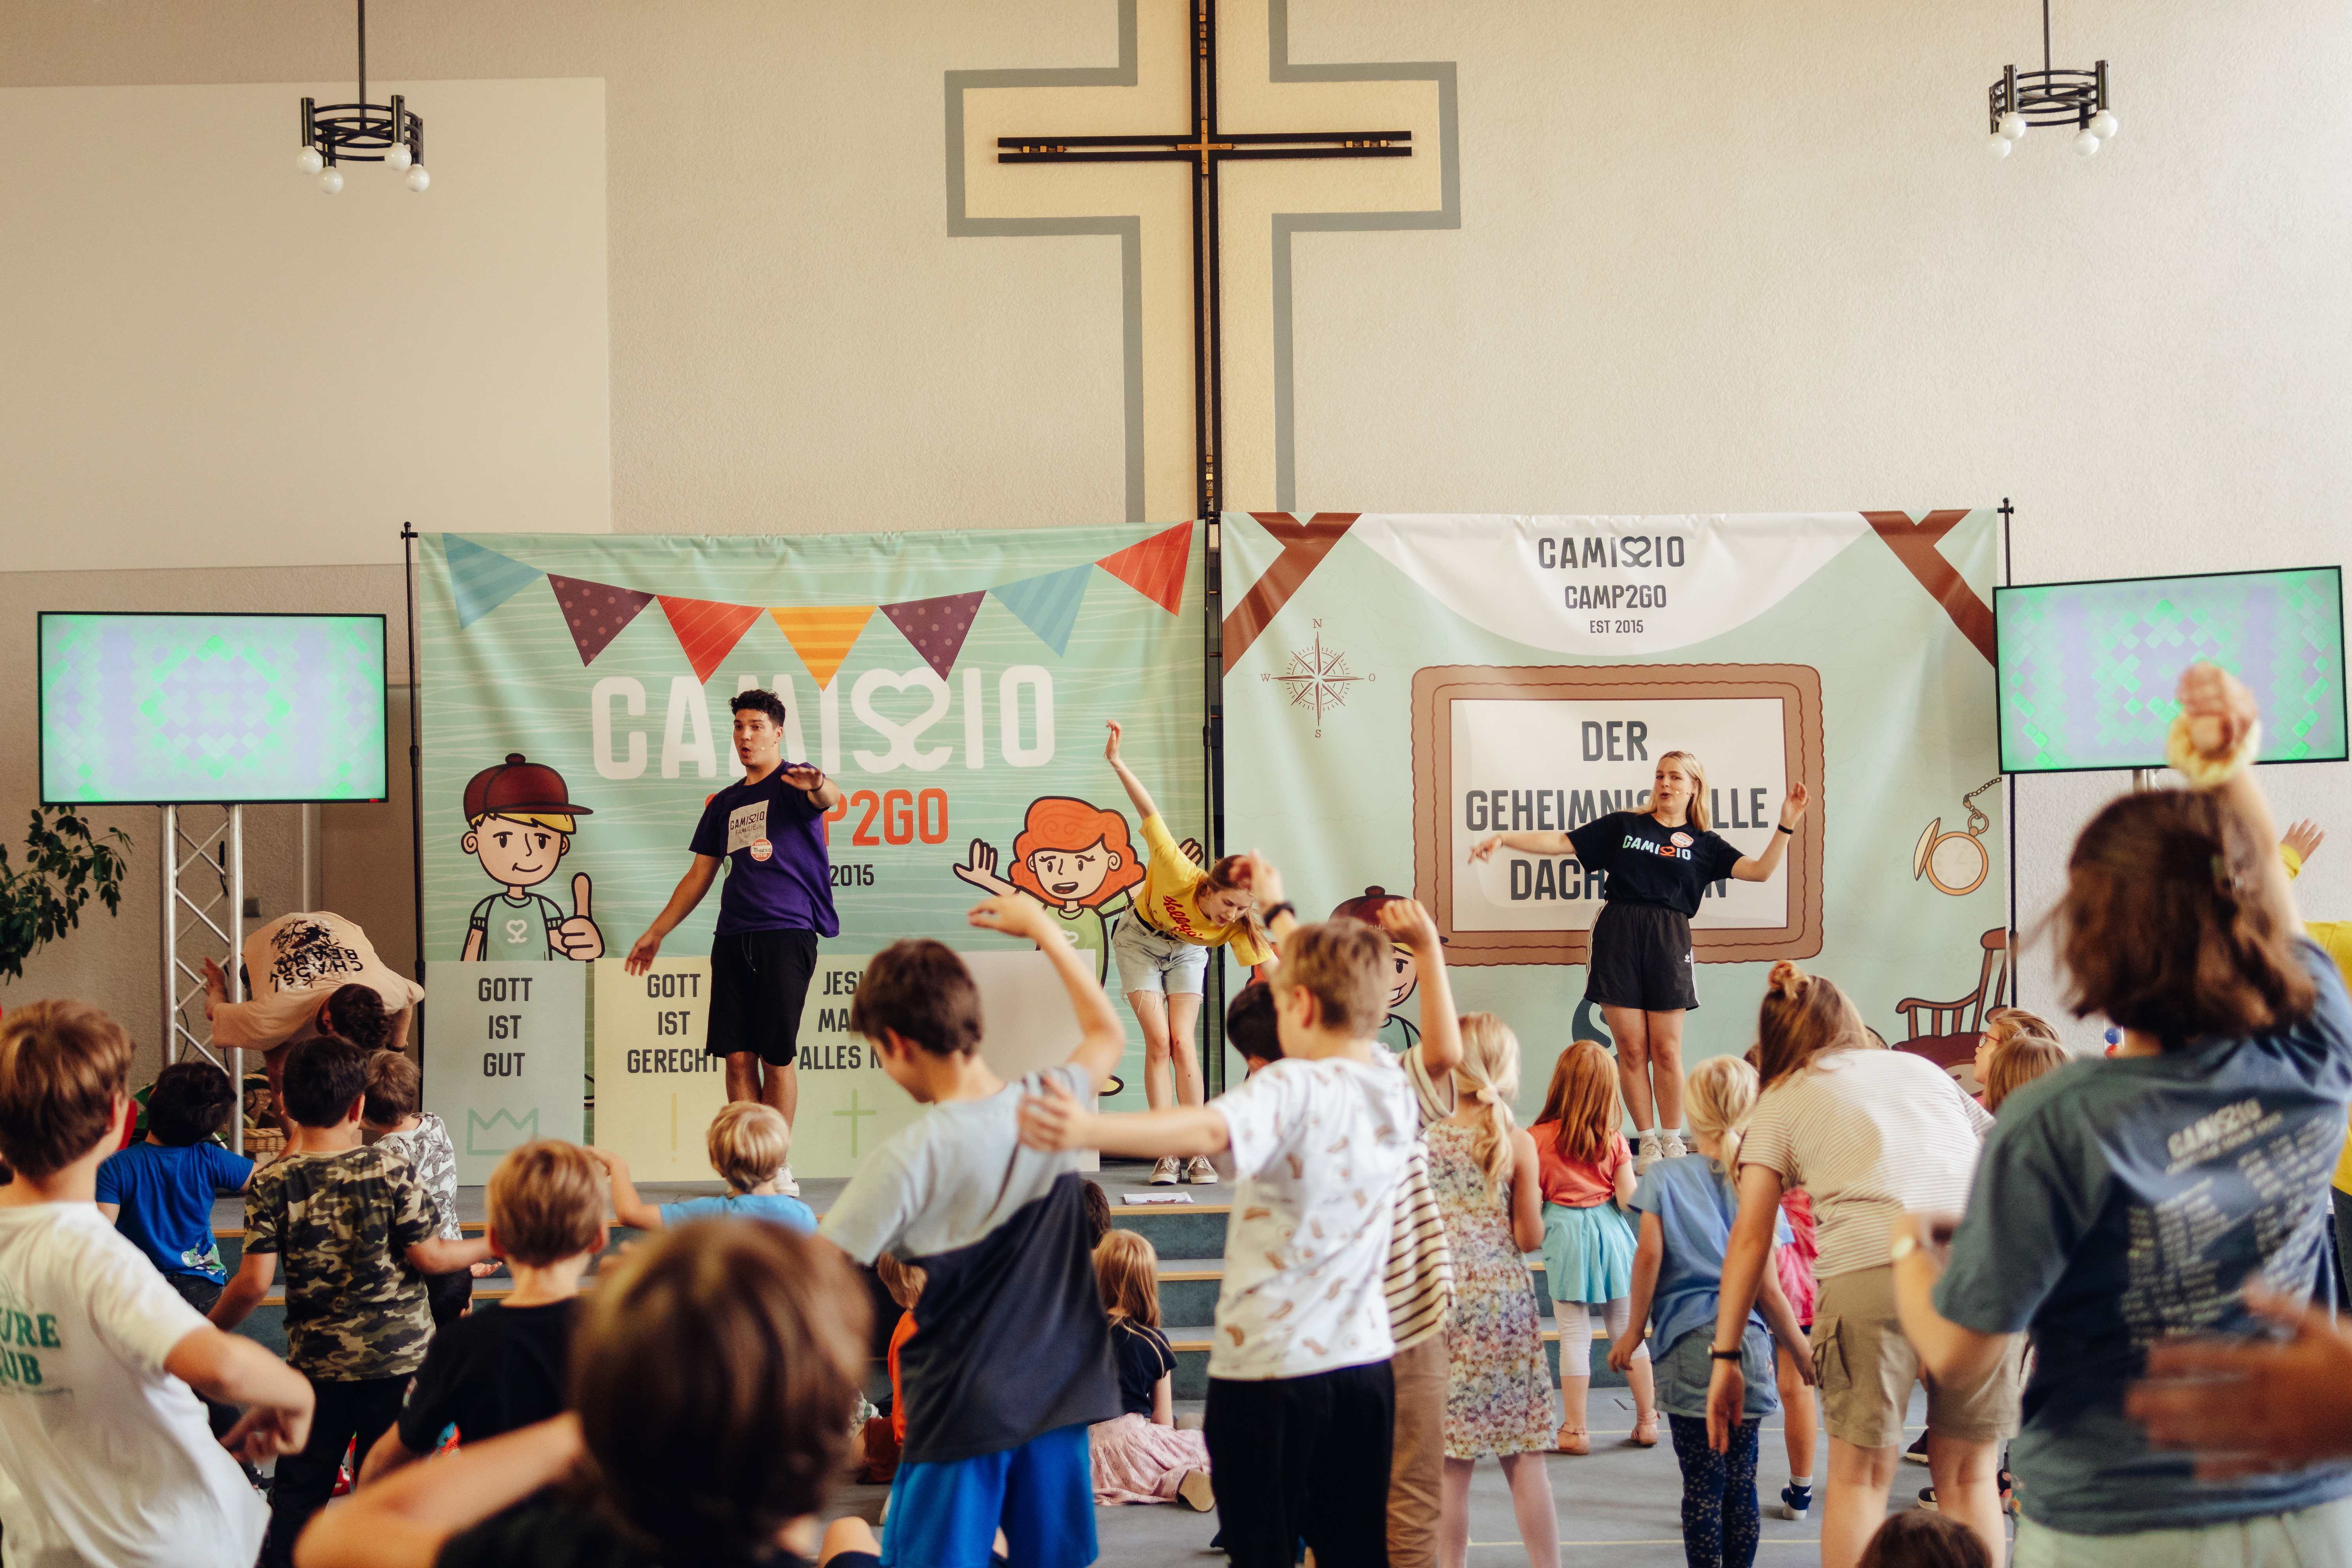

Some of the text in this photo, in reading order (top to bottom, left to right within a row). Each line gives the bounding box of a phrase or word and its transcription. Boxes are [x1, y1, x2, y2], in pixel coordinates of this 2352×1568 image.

[1538, 535, 1684, 568] CAMISSIO
[1564, 584, 1666, 608] CAMP2GO
[1312, 619, 1322, 628] N
[1590, 620, 1643, 633] EST 2015
[1260, 673, 1270, 682] W
[1368, 673, 1376, 681] O
[1315, 730, 1321, 738] S
[1582, 720, 1648, 761] DER
[735, 824, 757, 836] FAMILIE
[830, 864, 875, 887] 2015
[478, 977, 533, 1002] GOTT
[647, 973, 701, 998] GOTT
[488, 1015, 522, 1039] IST
[658, 1011, 690, 1035] IST
[483, 1052, 526, 1076] GUT
[799, 1045, 861, 1070] ALLES
[0, 1350, 43, 1386] UB
